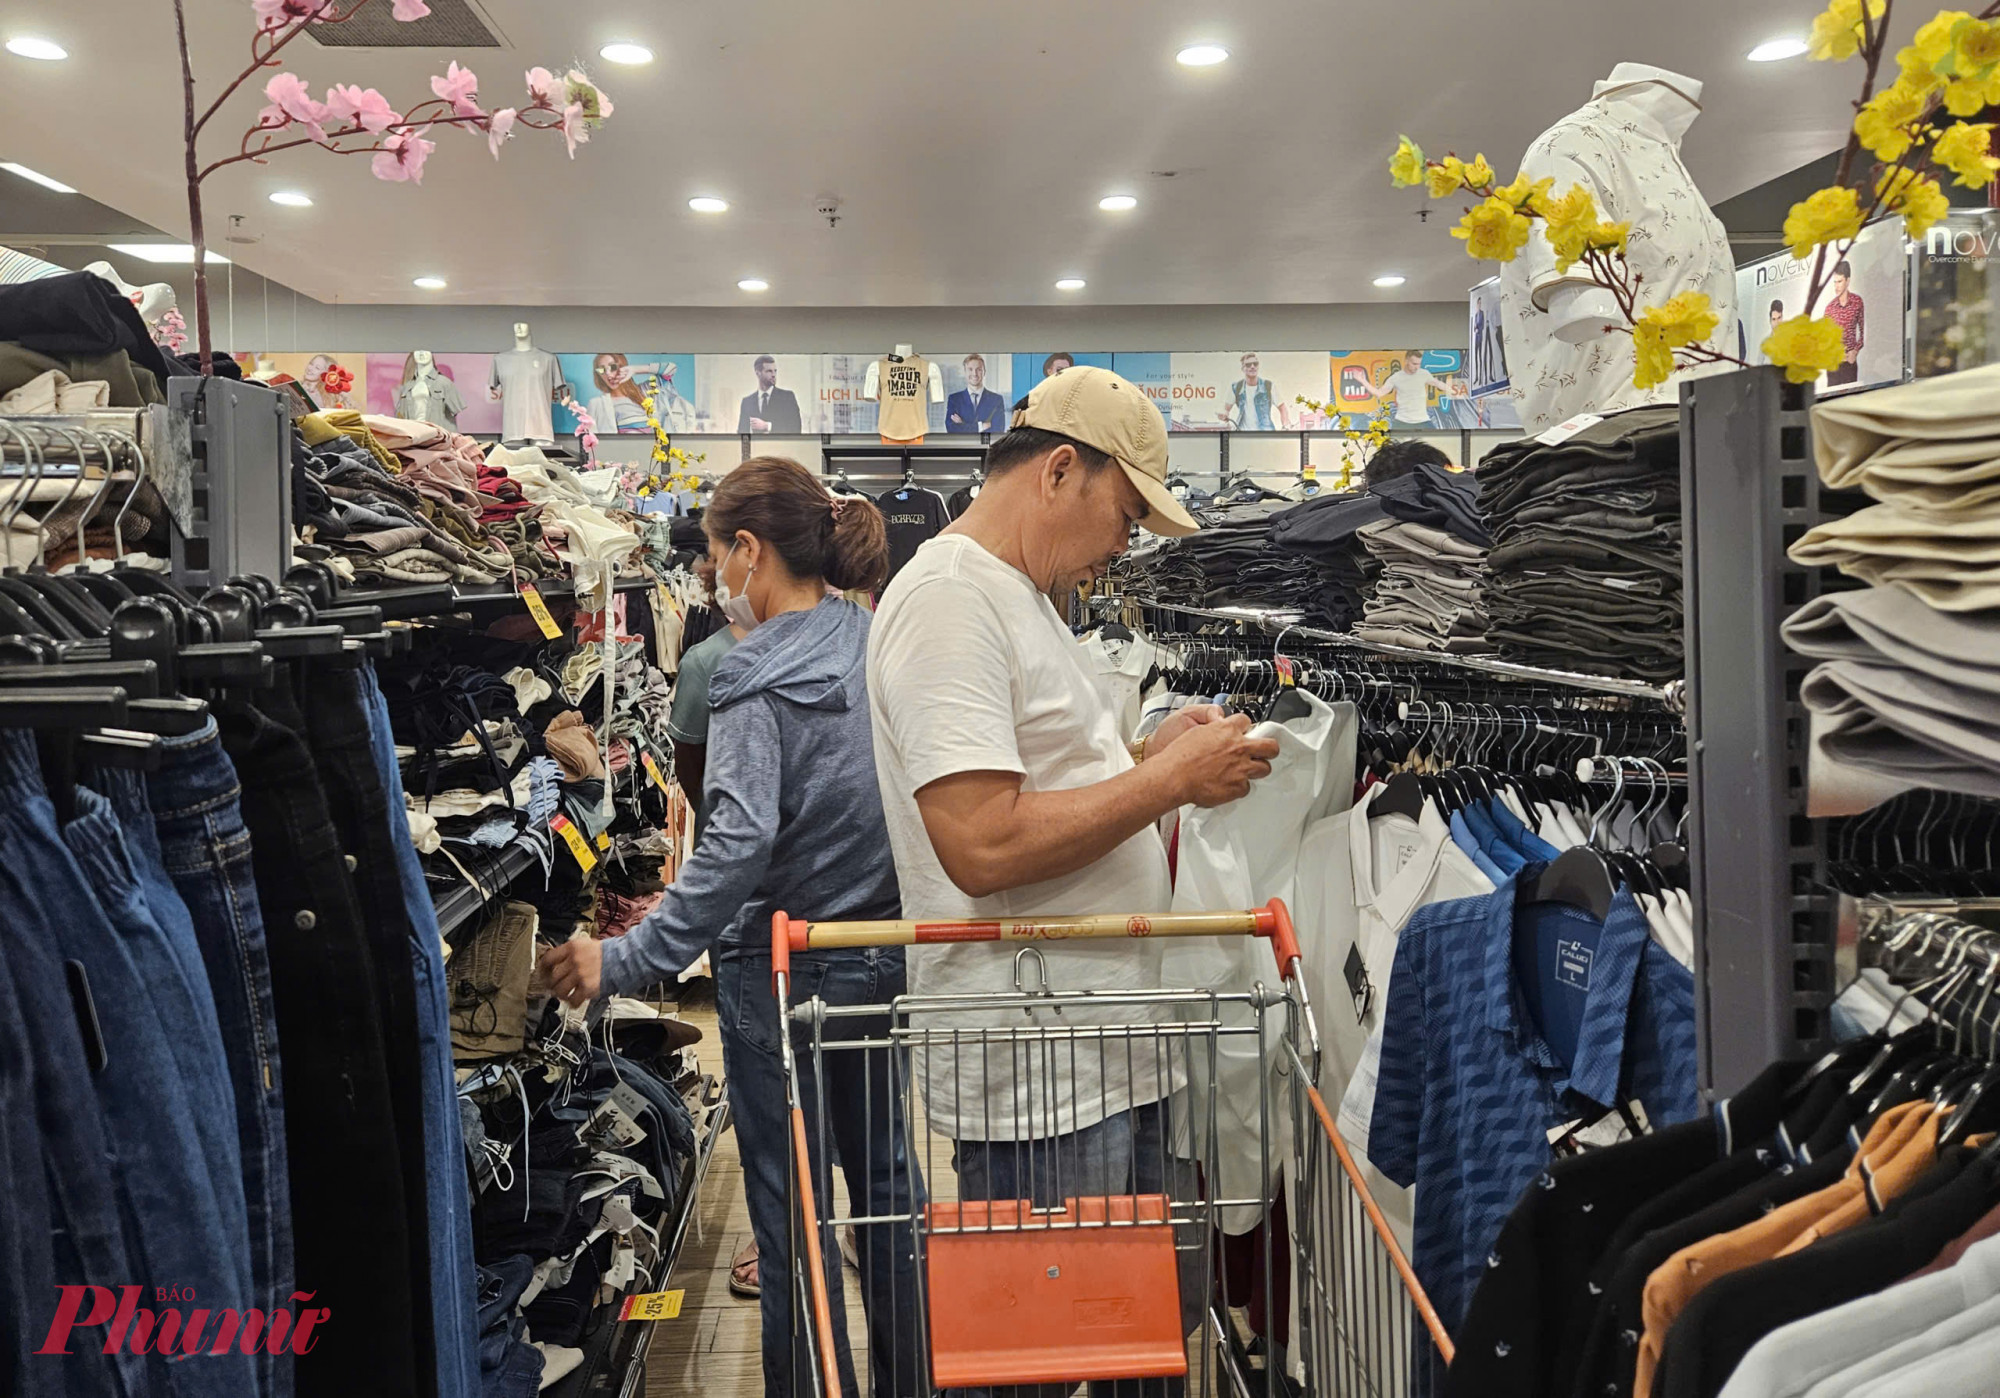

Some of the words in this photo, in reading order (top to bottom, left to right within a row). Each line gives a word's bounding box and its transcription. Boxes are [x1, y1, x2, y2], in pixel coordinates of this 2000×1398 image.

[1927, 227, 2000, 255] nov
[890, 371, 921, 384] YOUR
[888, 379, 917, 393] IMAGE
[890, 389, 916, 397] NOW
[1172, 384, 1216, 401] ĐỘNG
[820, 388, 850, 403] LỊCH
